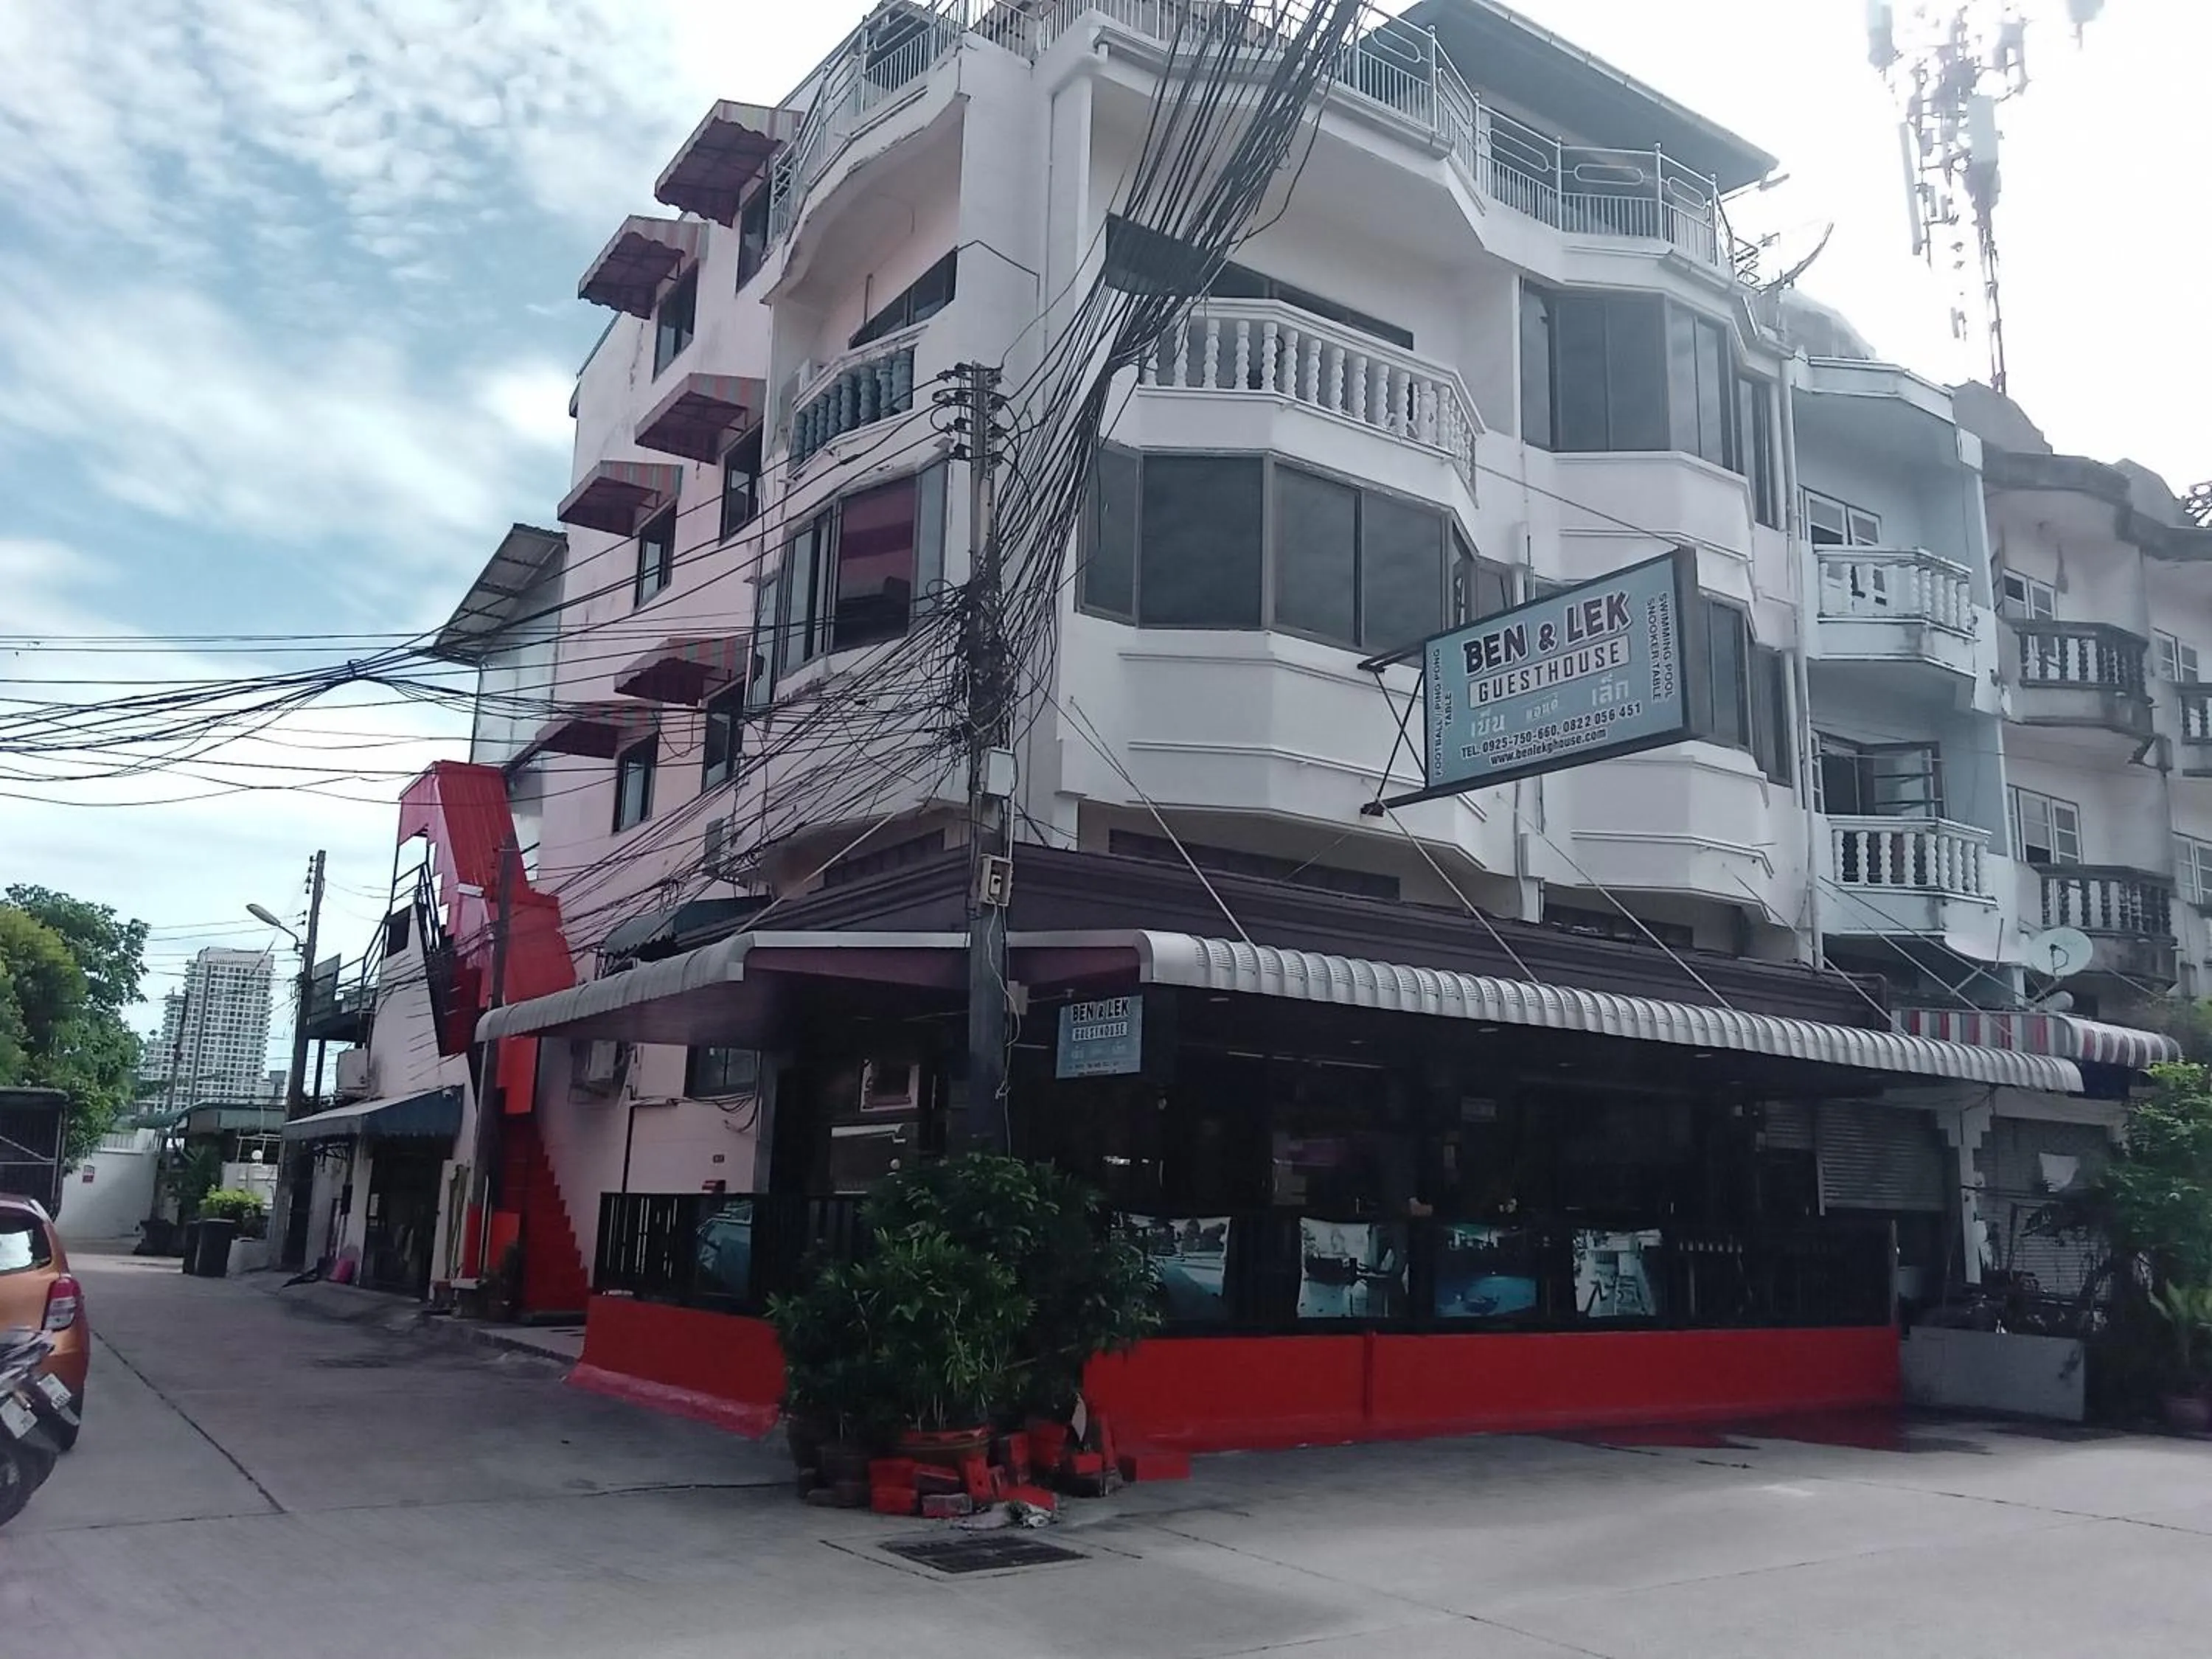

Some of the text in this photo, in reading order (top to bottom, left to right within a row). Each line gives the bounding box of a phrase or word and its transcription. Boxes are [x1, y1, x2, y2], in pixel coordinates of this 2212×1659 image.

[1463, 591, 1631, 675] BEN & LEK
[1647, 597, 1661, 700] SNOOKER TABLE
[1659, 592, 1673, 698] SWIMMING POOL
[1478, 641, 1621, 703] GUESTHOUSE
[1563, 714, 1591, 732] 0822
[1595, 709, 1615, 724] 056
[1618, 702, 1641, 717] 451
[1073, 1004, 1093, 1022] BEN
[1107, 999, 1129, 1018] LEK
